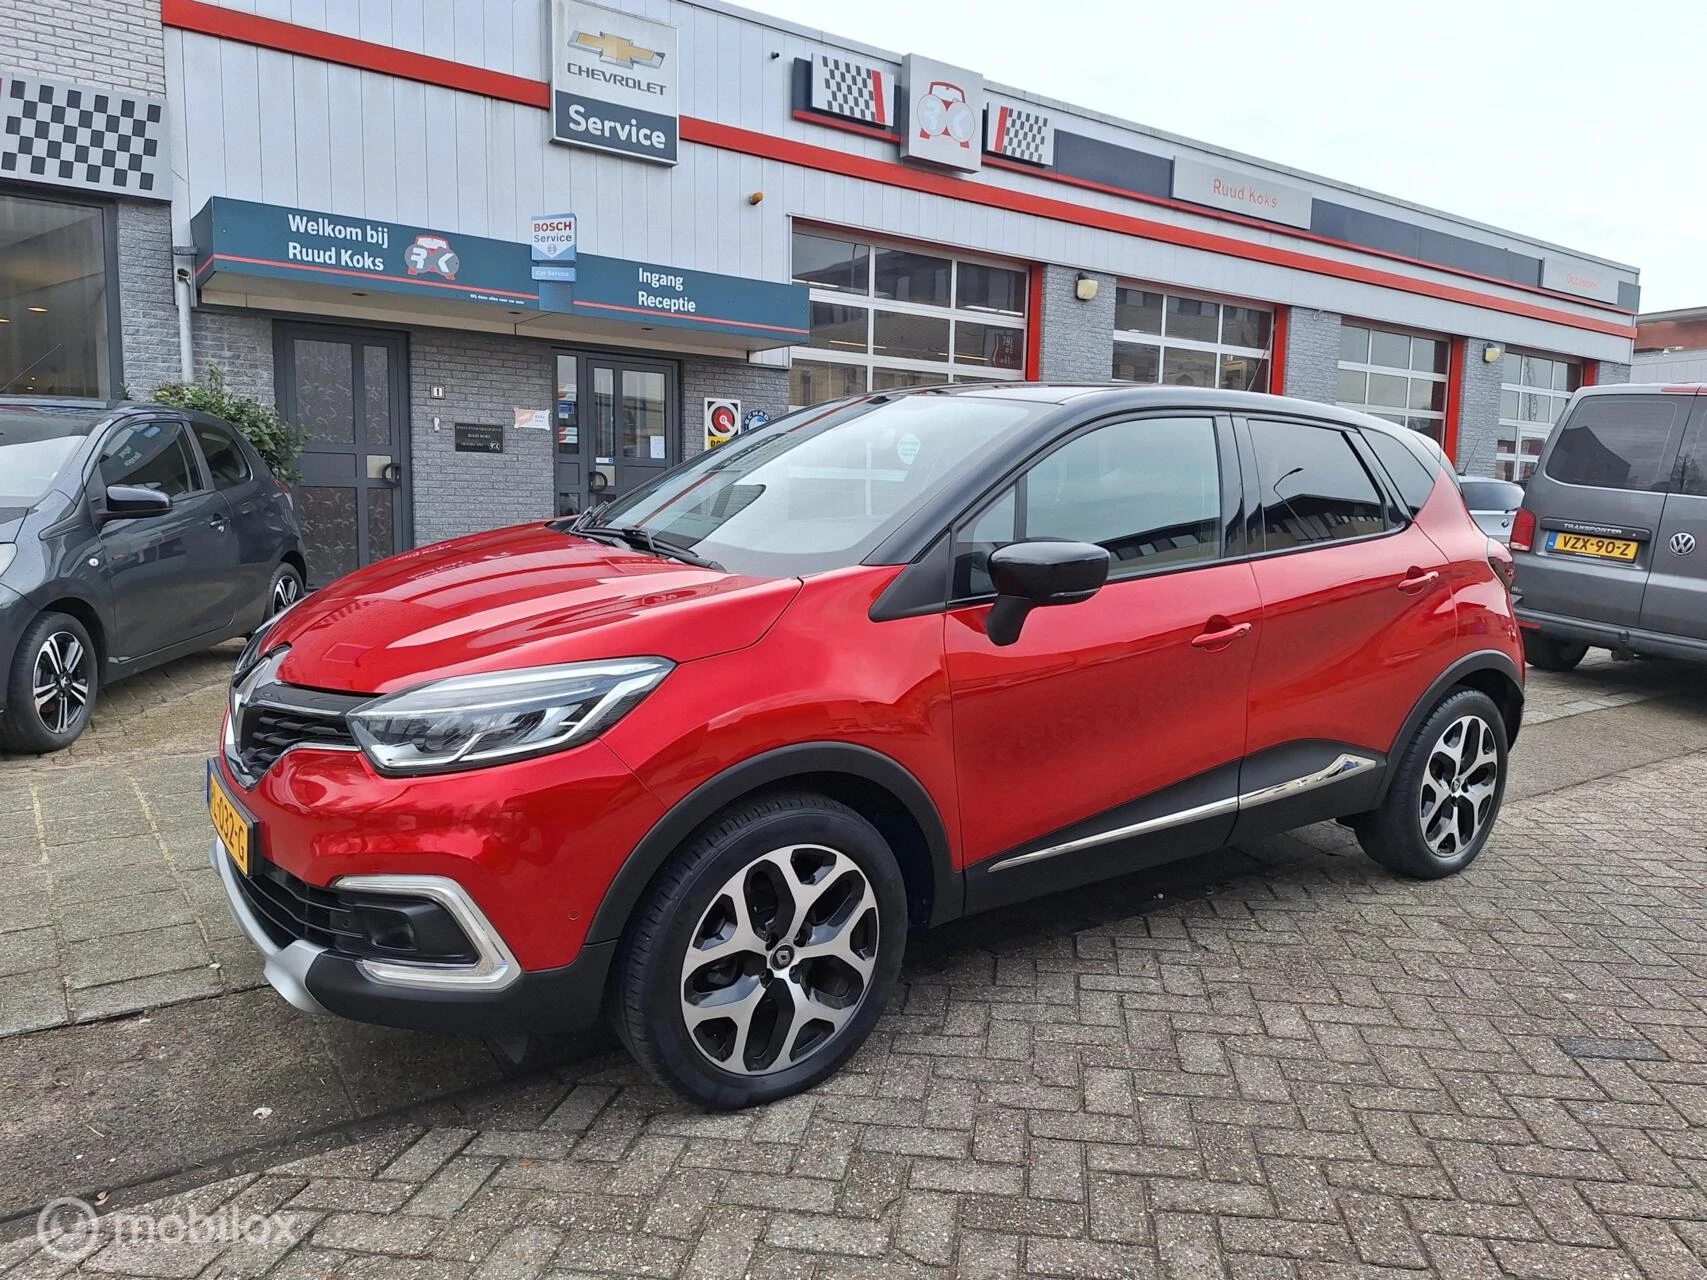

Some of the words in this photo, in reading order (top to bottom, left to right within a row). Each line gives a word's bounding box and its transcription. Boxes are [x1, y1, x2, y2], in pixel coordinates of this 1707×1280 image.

[567, 62, 667, 95] CHEVROLET
[568, 104, 666, 149] Service
[1213, 178, 1245, 201] Ruud
[1248, 187, 1278, 208] Koks
[288, 214, 362, 241] Welkom
[366, 225, 389, 248] bij
[533, 221, 572, 232] BOSCH
[533, 233, 572, 243] Service
[288, 241, 336, 265] Ruud
[340, 249, 384, 271] Koks
[638, 267, 684, 291] Ingang
[638, 291, 696, 313] Receptie
[1563, 523, 1622, 535] TRANSPORTER
[1563, 535, 1632, 556] VZX-90-Z
